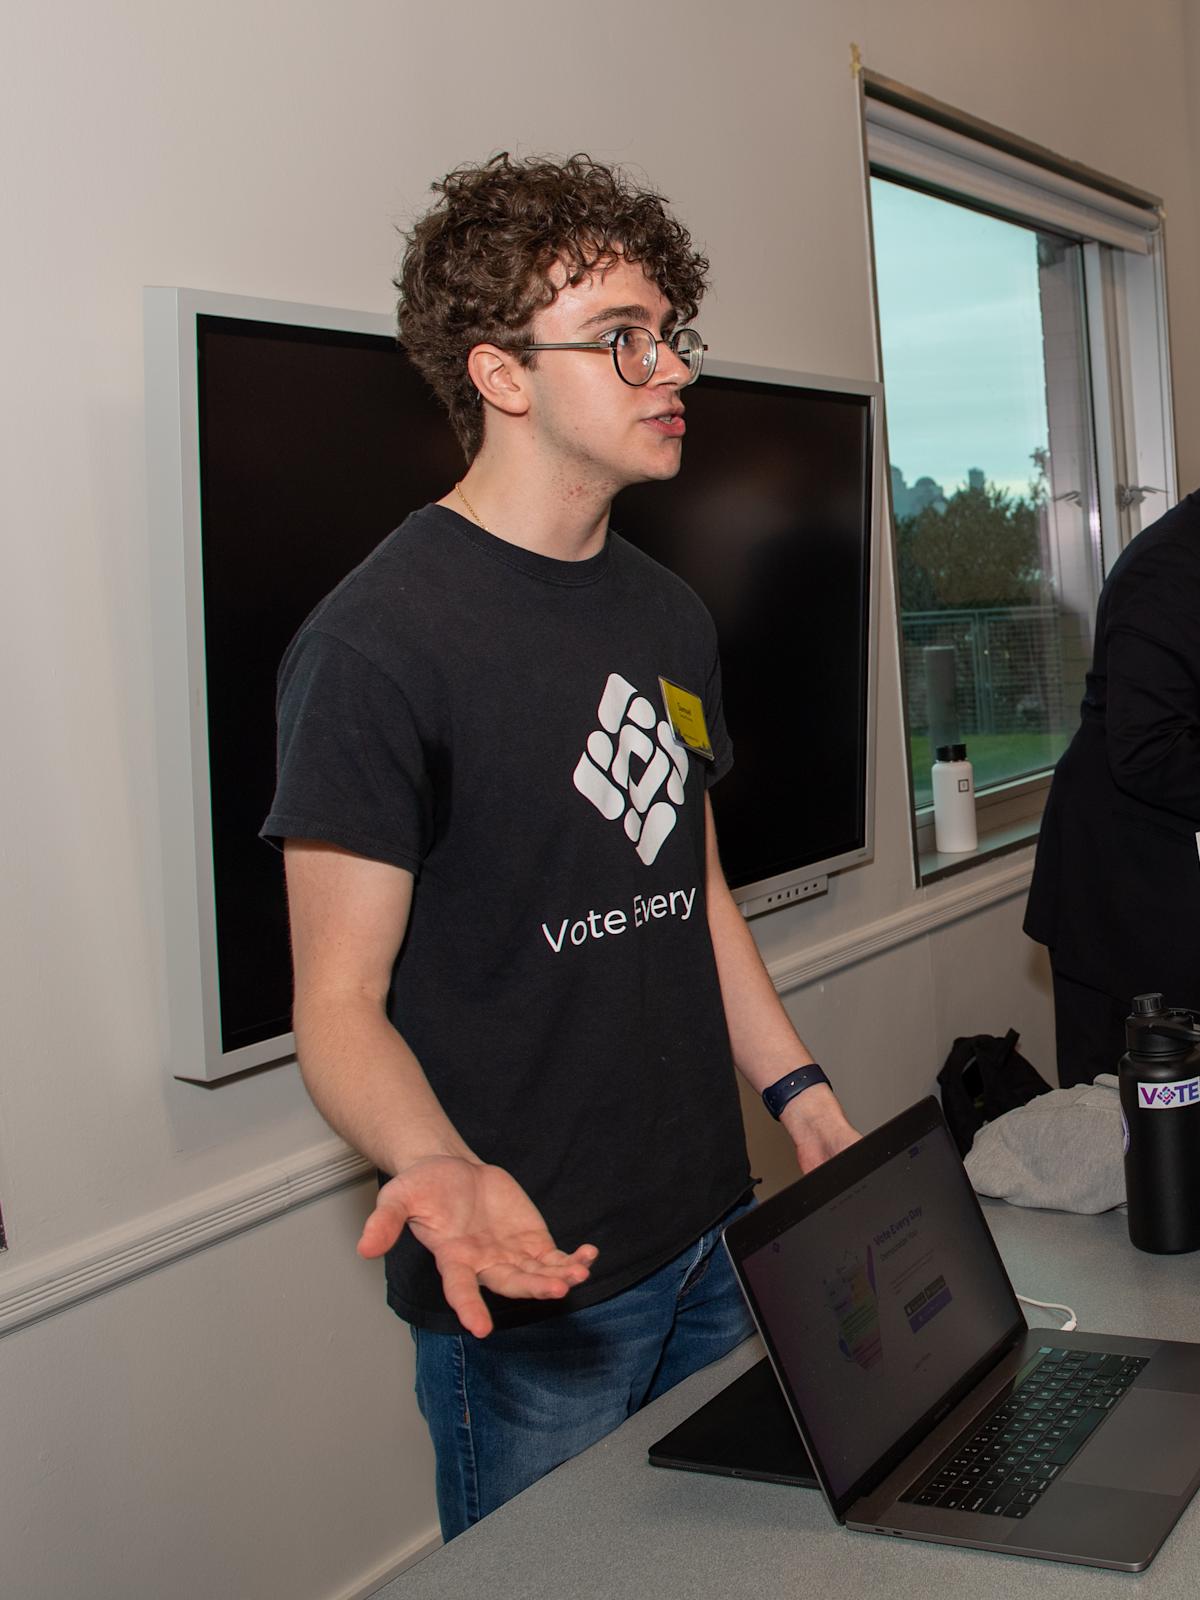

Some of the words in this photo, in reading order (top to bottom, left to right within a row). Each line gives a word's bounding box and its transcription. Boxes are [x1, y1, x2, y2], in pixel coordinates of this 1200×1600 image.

[541, 908, 627, 953] Vote
[633, 887, 696, 928] Every
[1140, 1081, 1200, 1105] VOTE
